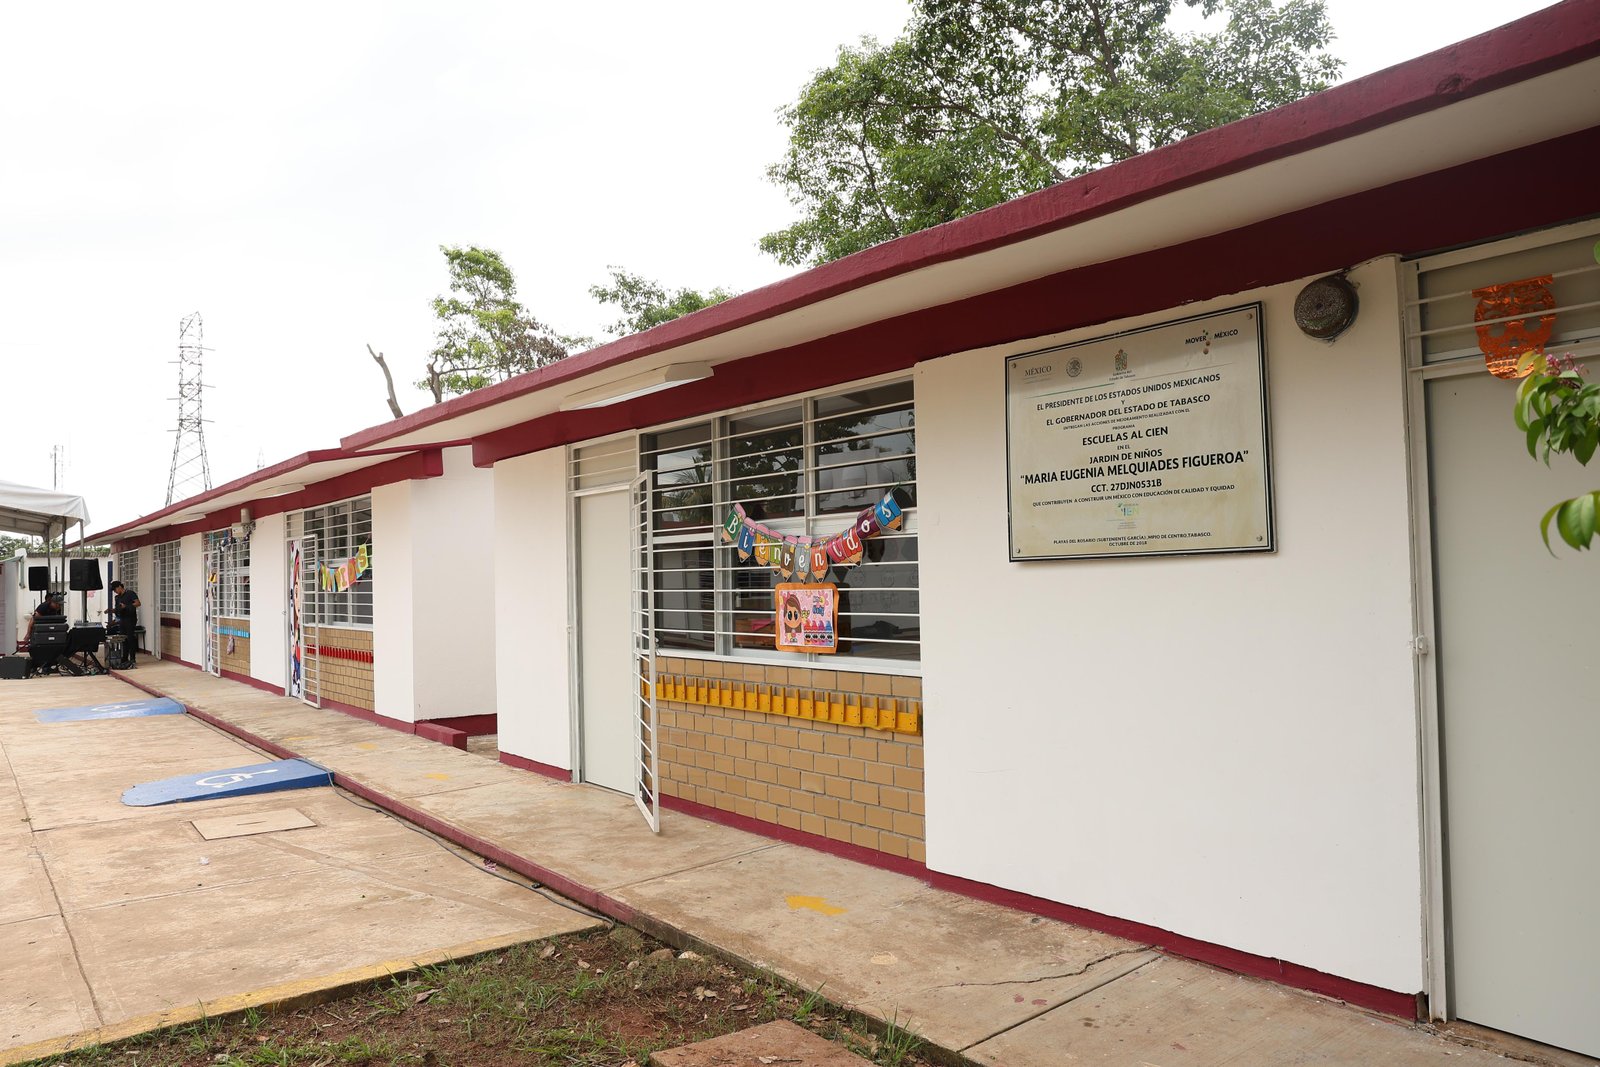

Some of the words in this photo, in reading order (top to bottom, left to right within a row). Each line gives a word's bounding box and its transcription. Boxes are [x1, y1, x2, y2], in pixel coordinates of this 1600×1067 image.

[1185, 334, 1207, 344] MOVER
[1213, 328, 1239, 339] MÉXICO
[1024, 365, 1052, 376] MÉXICO
[1044, 397, 1083, 409] PRESIDENTE
[1084, 395, 1093, 403] DE
[1094, 392, 1108, 402] LOS
[1108, 387, 1141, 399] ESTADOS
[1142, 381, 1172, 393] UNIDOS
[1173, 373, 1221, 388] MEXICANOS
[1055, 410, 1107, 425] GOBERNADOR
[1108, 408, 1122, 416] DEL
[1123, 402, 1156, 414] ESTADO
[1157, 400, 1168, 409] DE
[1170, 394, 1211, 407] TABASCO
[1082, 431, 1129, 446] ESCUELAS
[1130, 430, 1143, 440] AL
[1145, 426, 1168, 437] CIEN
[1089, 453, 1119, 464] JARDIN
[1121, 452, 1132, 461] DE
[1134, 448, 1163, 459] NIÑOS
[1020, 471, 1058, 485] “MARIA
[1060, 466, 1105, 481] EUGENIA
[1107, 457, 1179, 476] MELQUIADES
[1182, 450, 1249, 468] FIGUEROA”
[1077, 495, 1104, 503] CONSTRUIR
[1143, 489, 1173, 497] EDUCACIÓN
[1209, 484, 1235, 492] EQUIDAD
[1090, 483, 1109, 493] CCT.
[1110, 478, 1162, 491] 27DJN0531B
[727, 507, 893, 568] Bienvenidos
